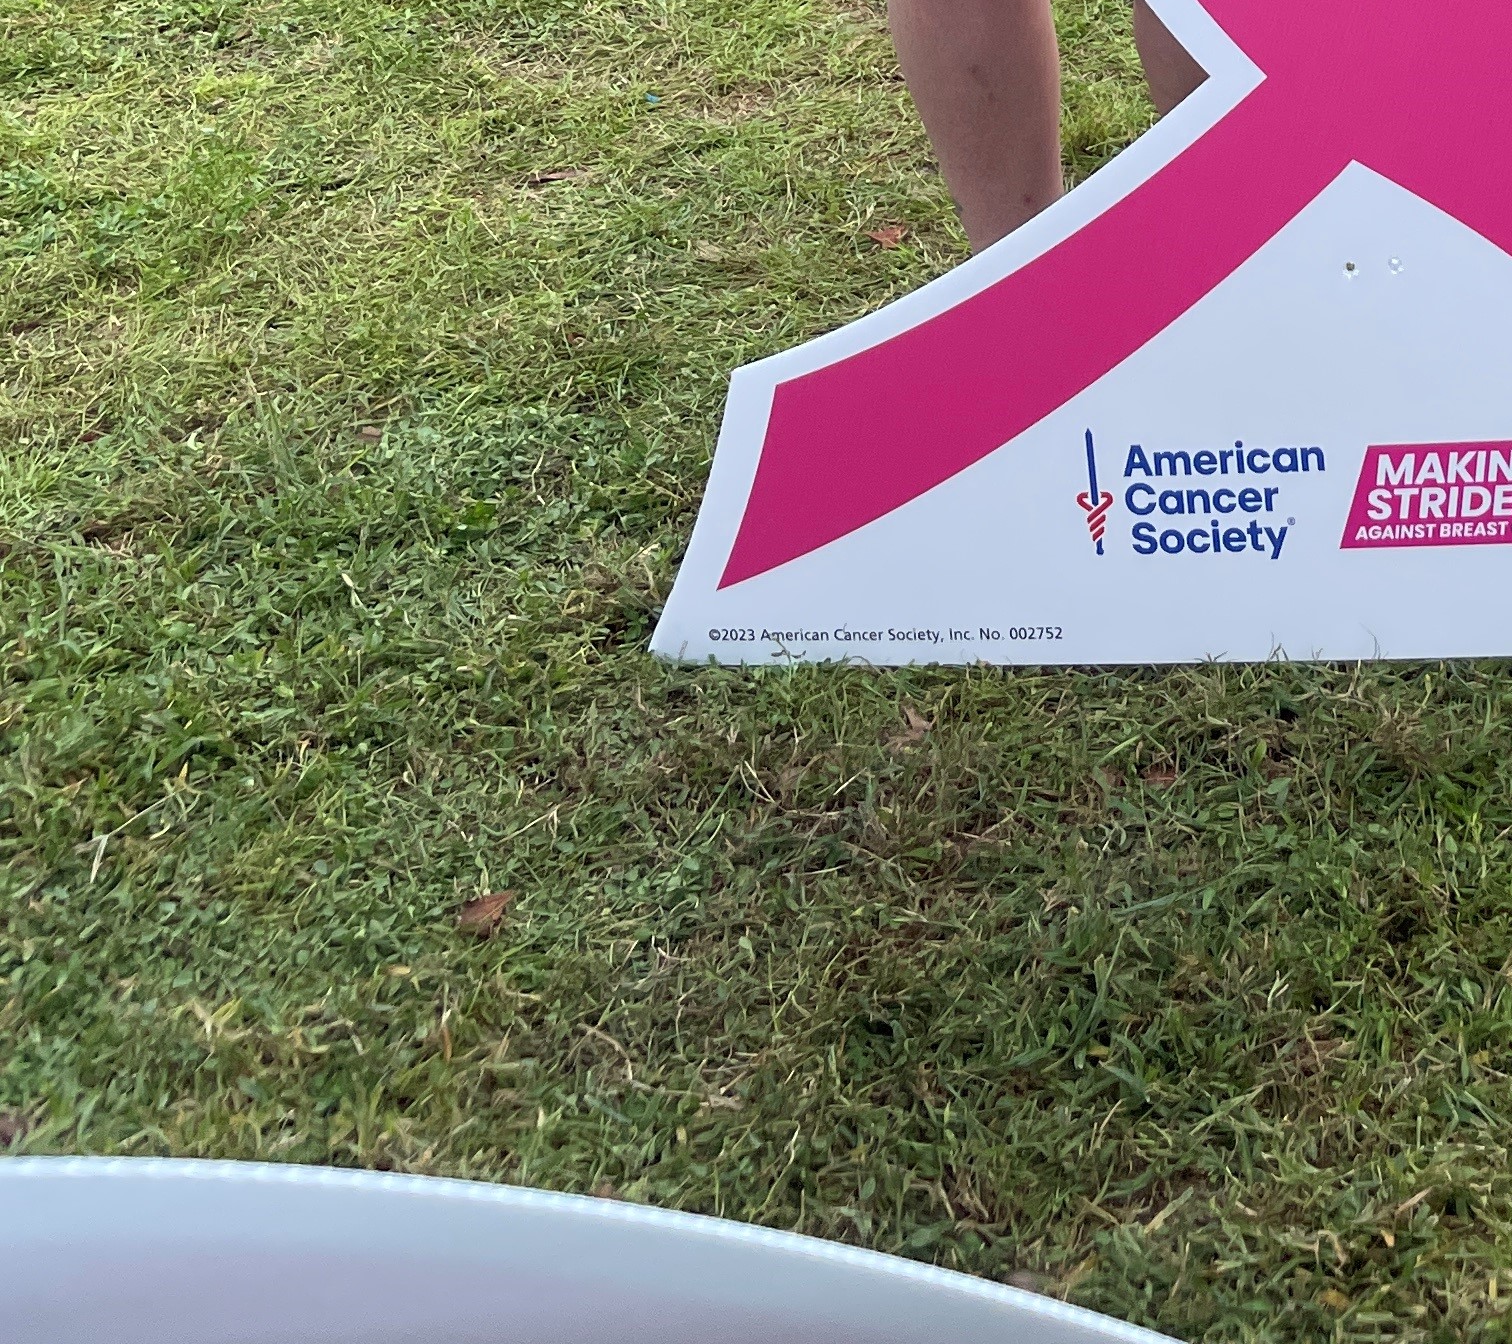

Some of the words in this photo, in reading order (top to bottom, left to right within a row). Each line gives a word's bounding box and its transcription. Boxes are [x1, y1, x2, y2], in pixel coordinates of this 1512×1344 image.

[1123, 441, 1325, 478] American
[1125, 482, 1279, 515] Cancer
[1355, 522, 1436, 542] AGAINST
[1439, 520, 1509, 539] BREAST
[708, 628, 756, 642] ©2023
[760, 627, 829, 642] American
[833, 627, 884, 642] Cancer
[888, 627, 945, 644] Society,
[949, 627, 975, 642] Inc.
[979, 627, 1005, 641] No.
[1009, 626, 1063, 641] 002752
